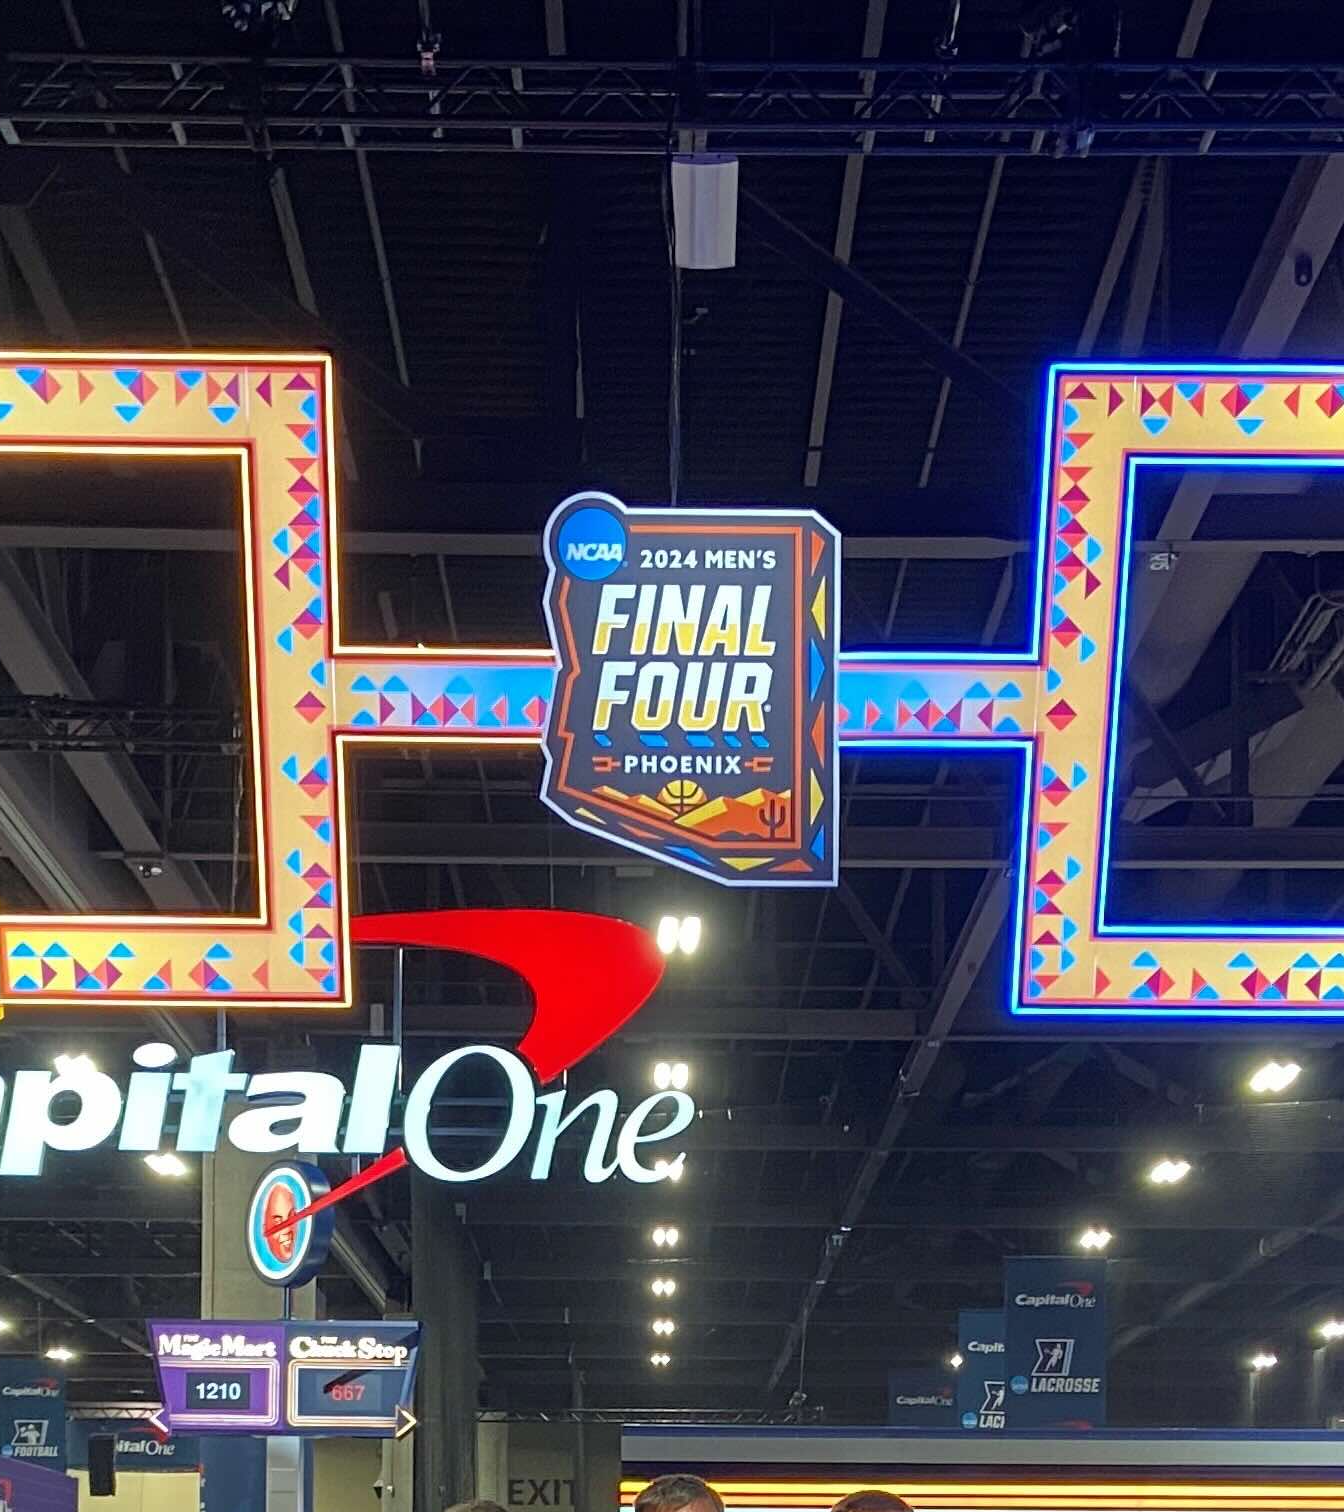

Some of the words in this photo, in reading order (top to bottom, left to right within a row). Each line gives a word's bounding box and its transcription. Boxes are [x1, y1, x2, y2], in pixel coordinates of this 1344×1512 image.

[564, 543, 624, 562] NCAA
[639, 549, 698, 570] 2024
[704, 549, 777, 570] MEN'S
[591, 584, 777, 657] FINAL
[591, 661, 773, 733] FOUR
[623, 755, 743, 776] PHOENIX
[357, 1337, 408, 1366] Stop
[196, 1382, 241, 1401] 1210
[330, 1384, 366, 1401] 667
[1031, 1377, 1101, 1394] LACROSSE
[978, 1415, 1006, 1429] LAC
[13, 1446, 59, 1457] FOOTBALL
[508, 1479, 575, 1506] EXIT
